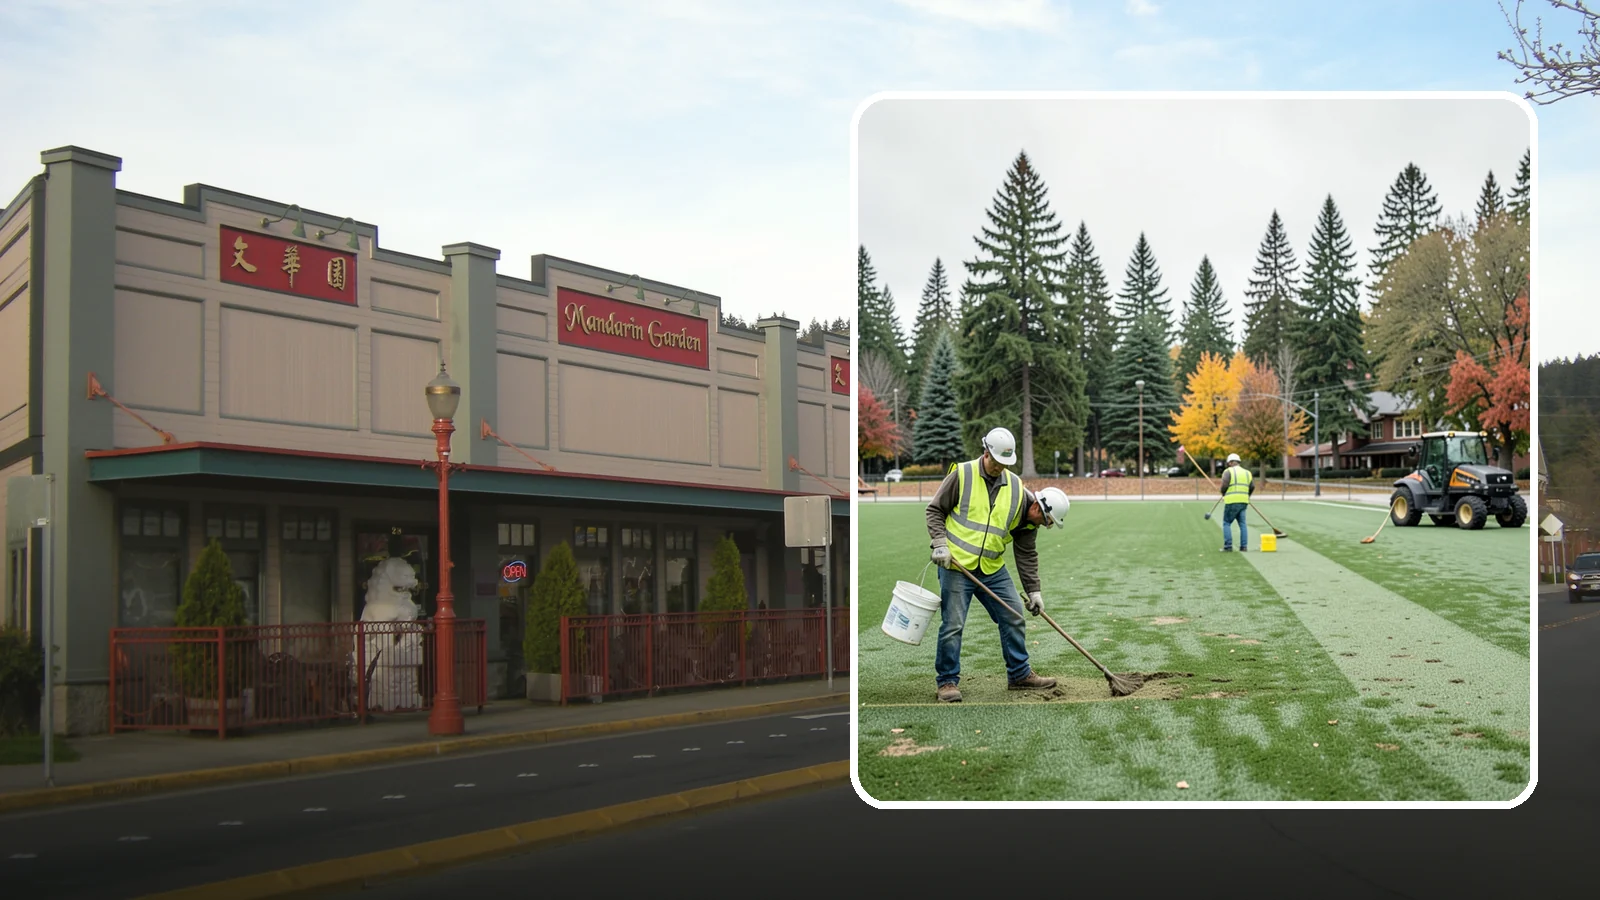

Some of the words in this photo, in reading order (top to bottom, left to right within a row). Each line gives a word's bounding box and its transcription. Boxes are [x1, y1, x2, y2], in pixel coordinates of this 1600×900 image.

[231, 236, 346, 290] 文華園
[564, 302, 644, 340] Mandarin
[648, 320, 701, 352] Garden
[503, 565, 526, 578] OPEN
